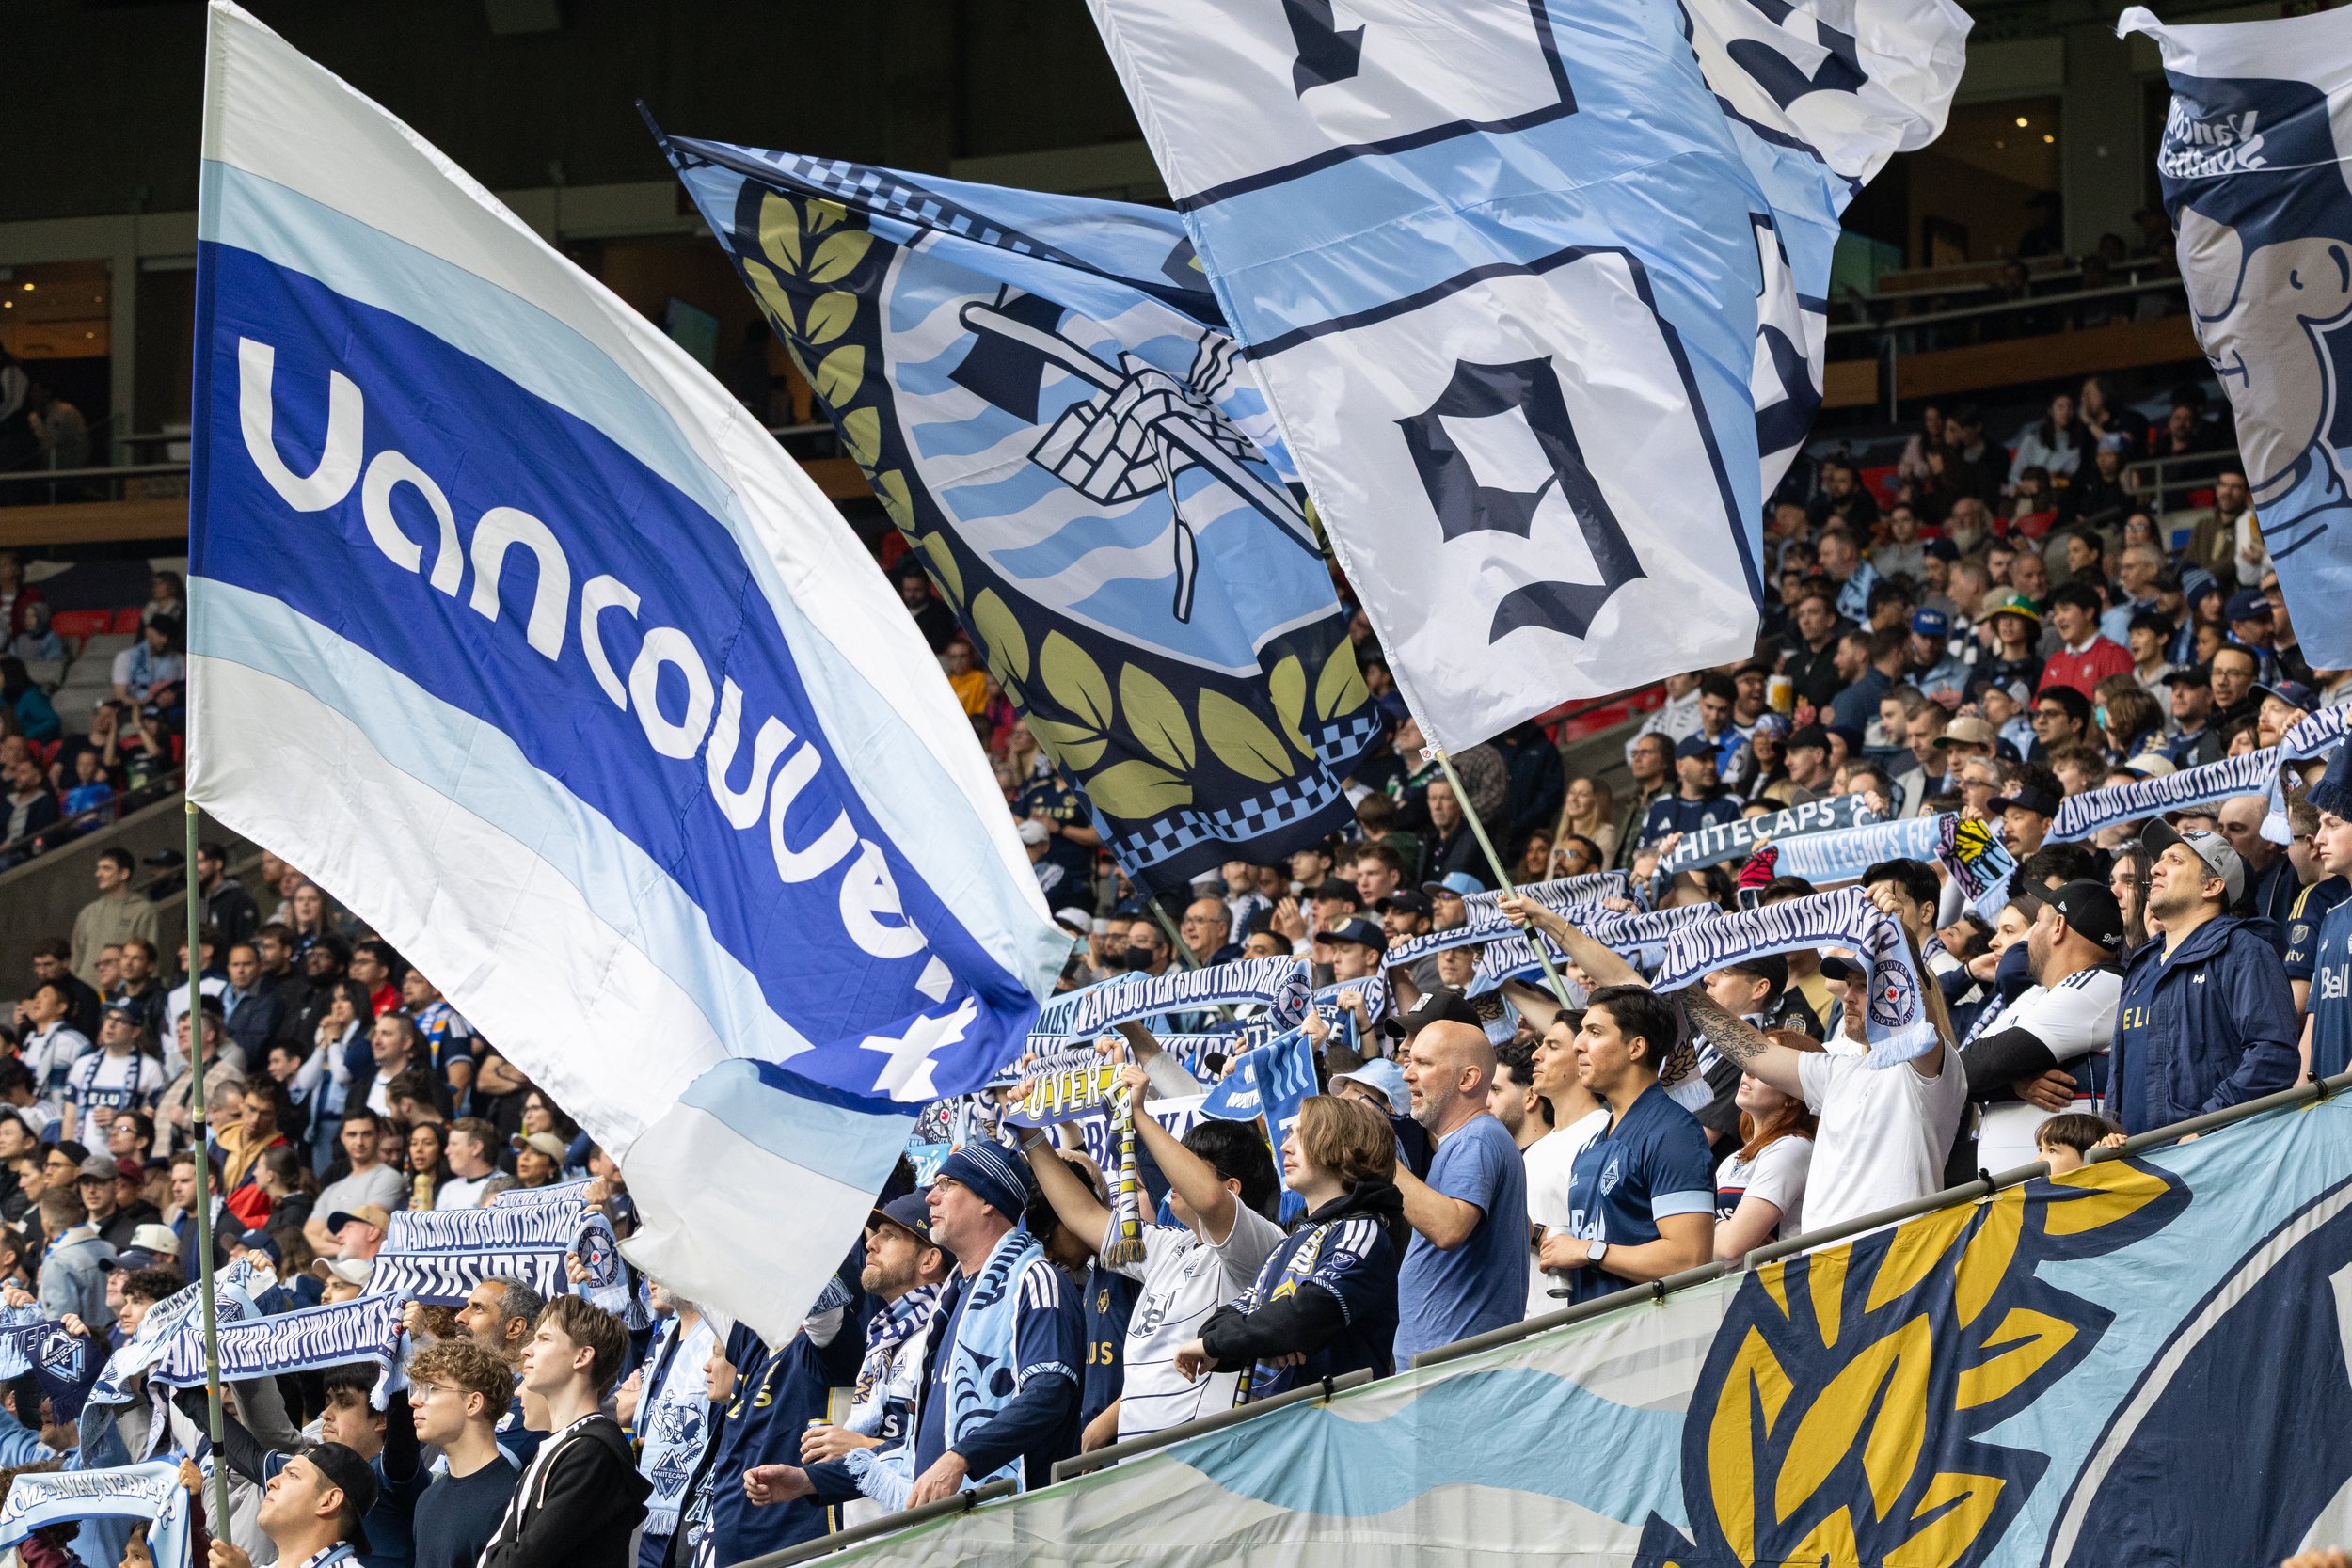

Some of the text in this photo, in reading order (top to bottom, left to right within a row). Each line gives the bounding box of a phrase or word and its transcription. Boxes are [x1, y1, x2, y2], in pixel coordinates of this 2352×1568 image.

[1788, 816, 1931, 877] WHITECAPS FC
[2321, 963, 2350, 1000] Bell
[42, 1340, 82, 1367] WHITECAPS
[61, 1355, 71, 1366] FC
[652, 1470, 688, 1480] WHITECAPS
